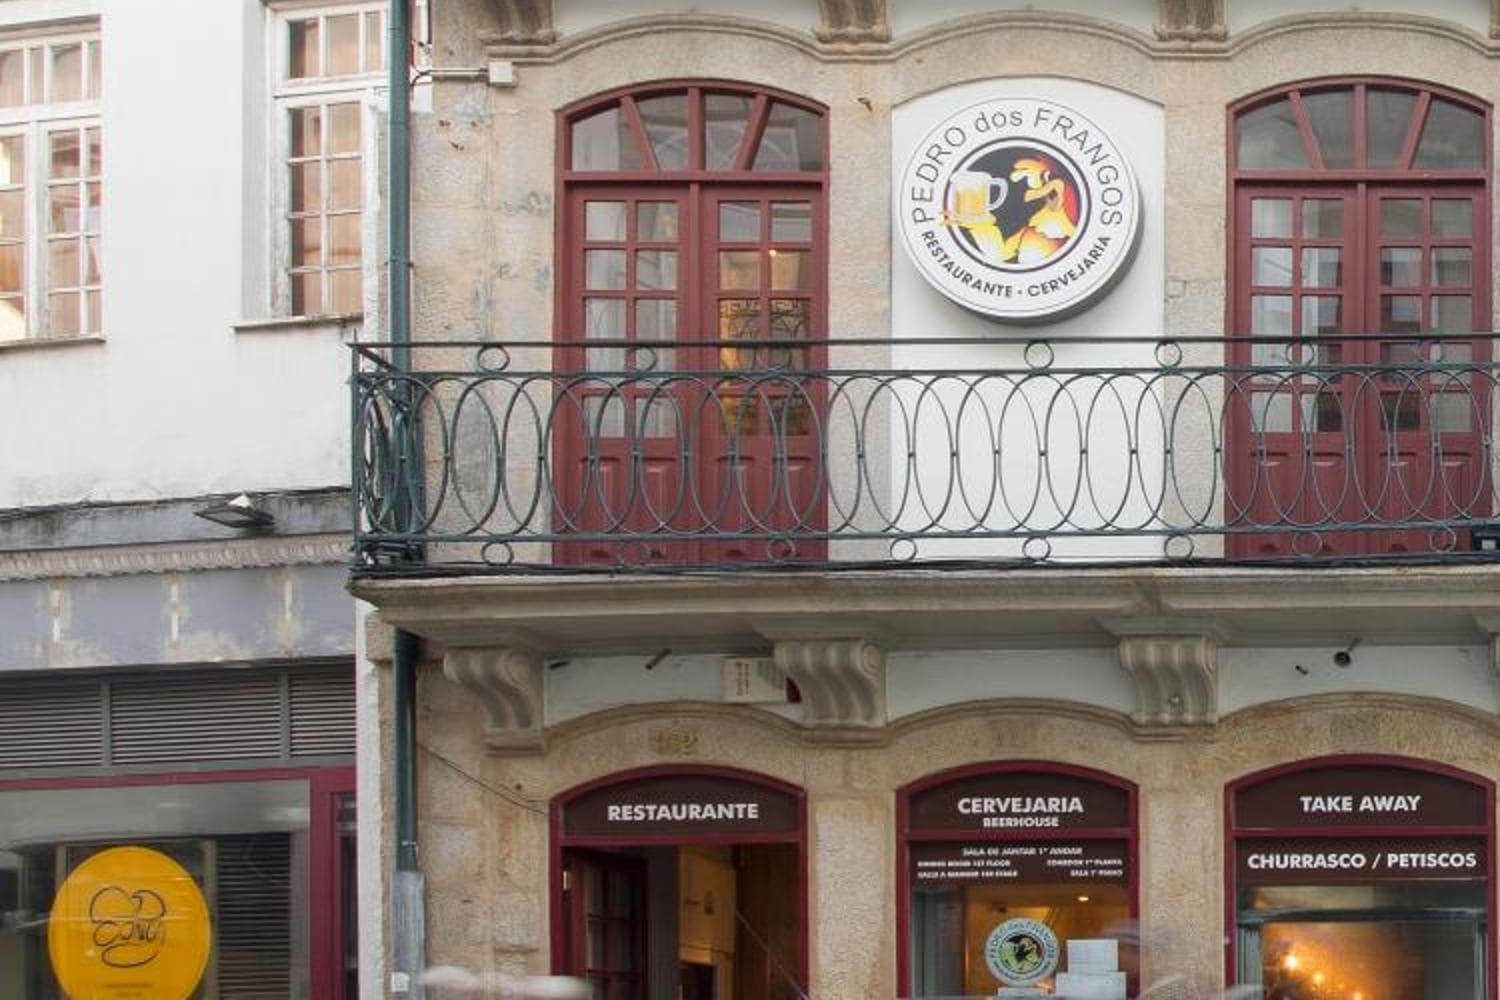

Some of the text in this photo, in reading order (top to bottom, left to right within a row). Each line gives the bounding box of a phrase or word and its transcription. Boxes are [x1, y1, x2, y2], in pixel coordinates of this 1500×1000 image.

[911, 107, 1124, 227] PEDRO dos FRANGOS
[921, 230, 1112, 298] RESTAURANTE CERVEJARIA
[607, 803, 760, 821] RESTAURANTE
[957, 797, 1084, 814] CERVEJARIA
[1299, 795, 1421, 813] TAKE AWAY
[982, 816, 1060, 827] BEERHOUSE
[1247, 853, 1478, 870] CHURRASCO / PETISCOS
